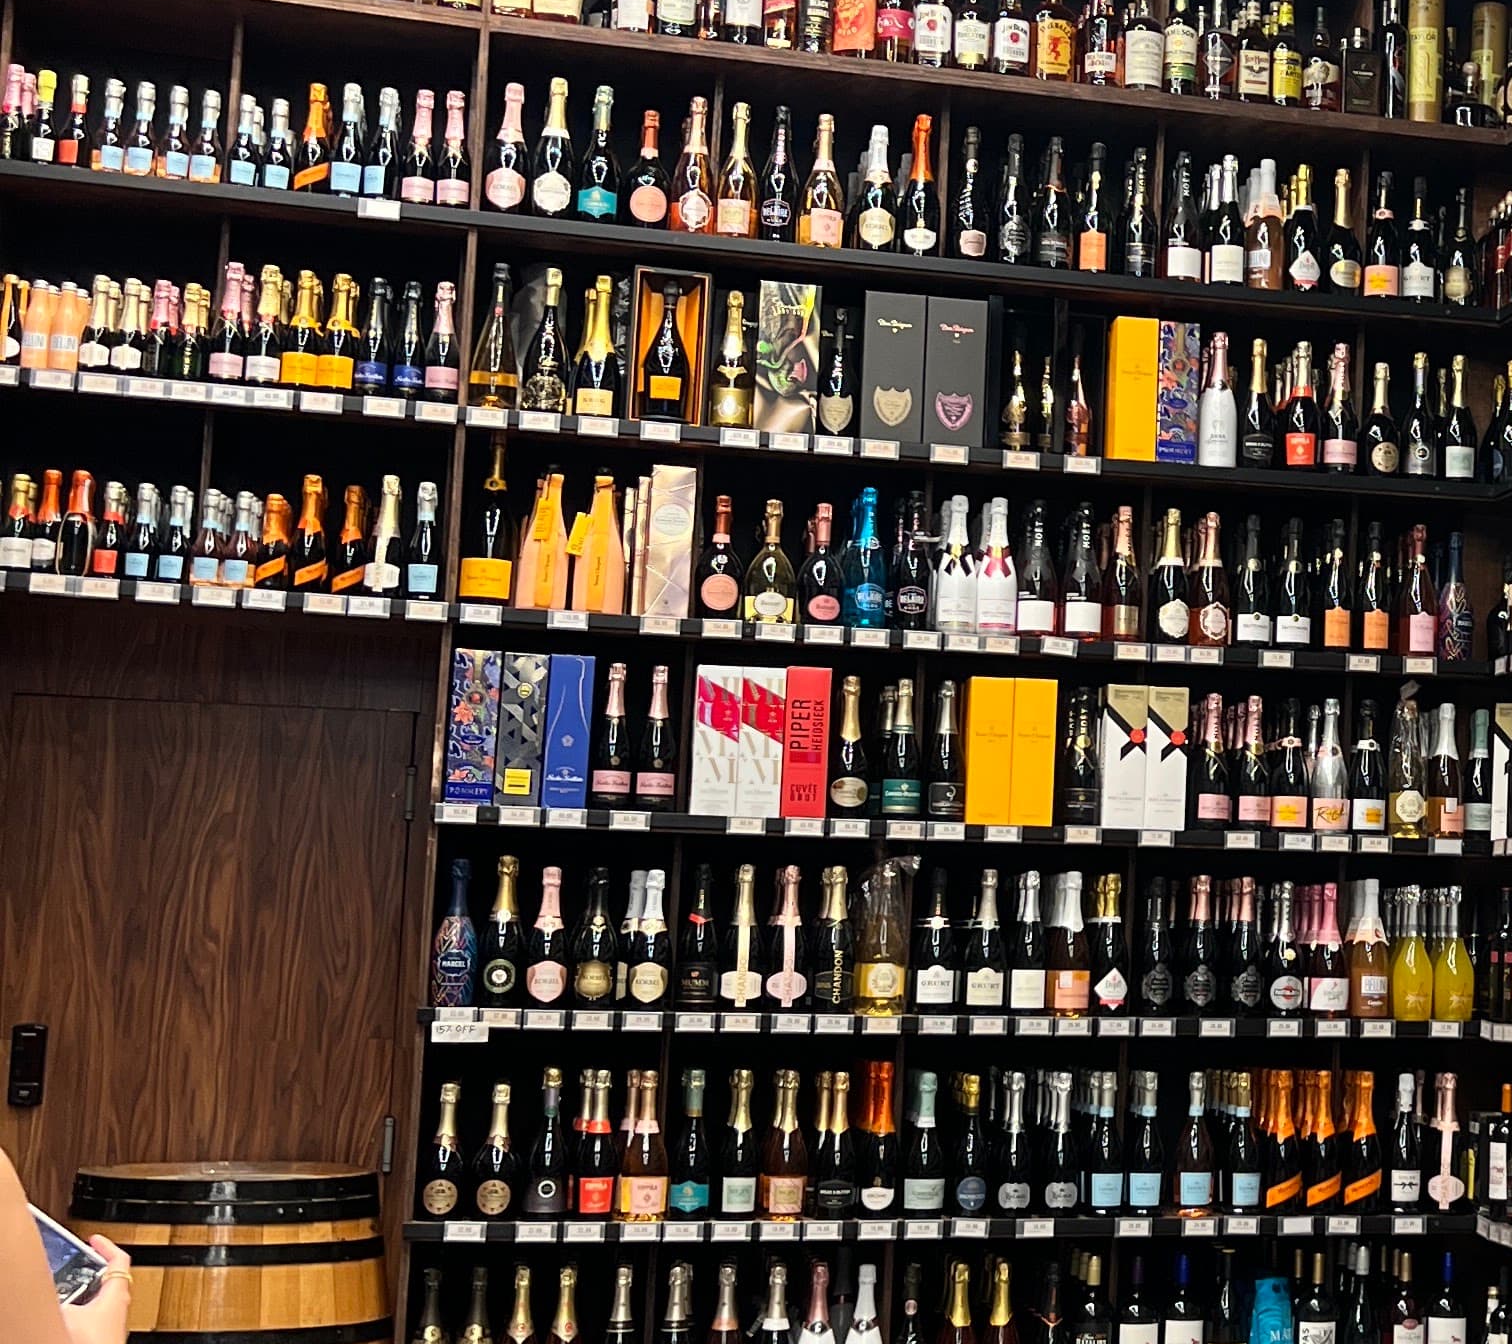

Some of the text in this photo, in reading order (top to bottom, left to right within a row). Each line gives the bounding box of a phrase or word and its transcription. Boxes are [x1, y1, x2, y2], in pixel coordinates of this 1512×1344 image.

[789, 698, 812, 752] PIPER
[811, 699, 825, 752] HEIDSIECK
[832, 948, 843, 1004] CHANDON
